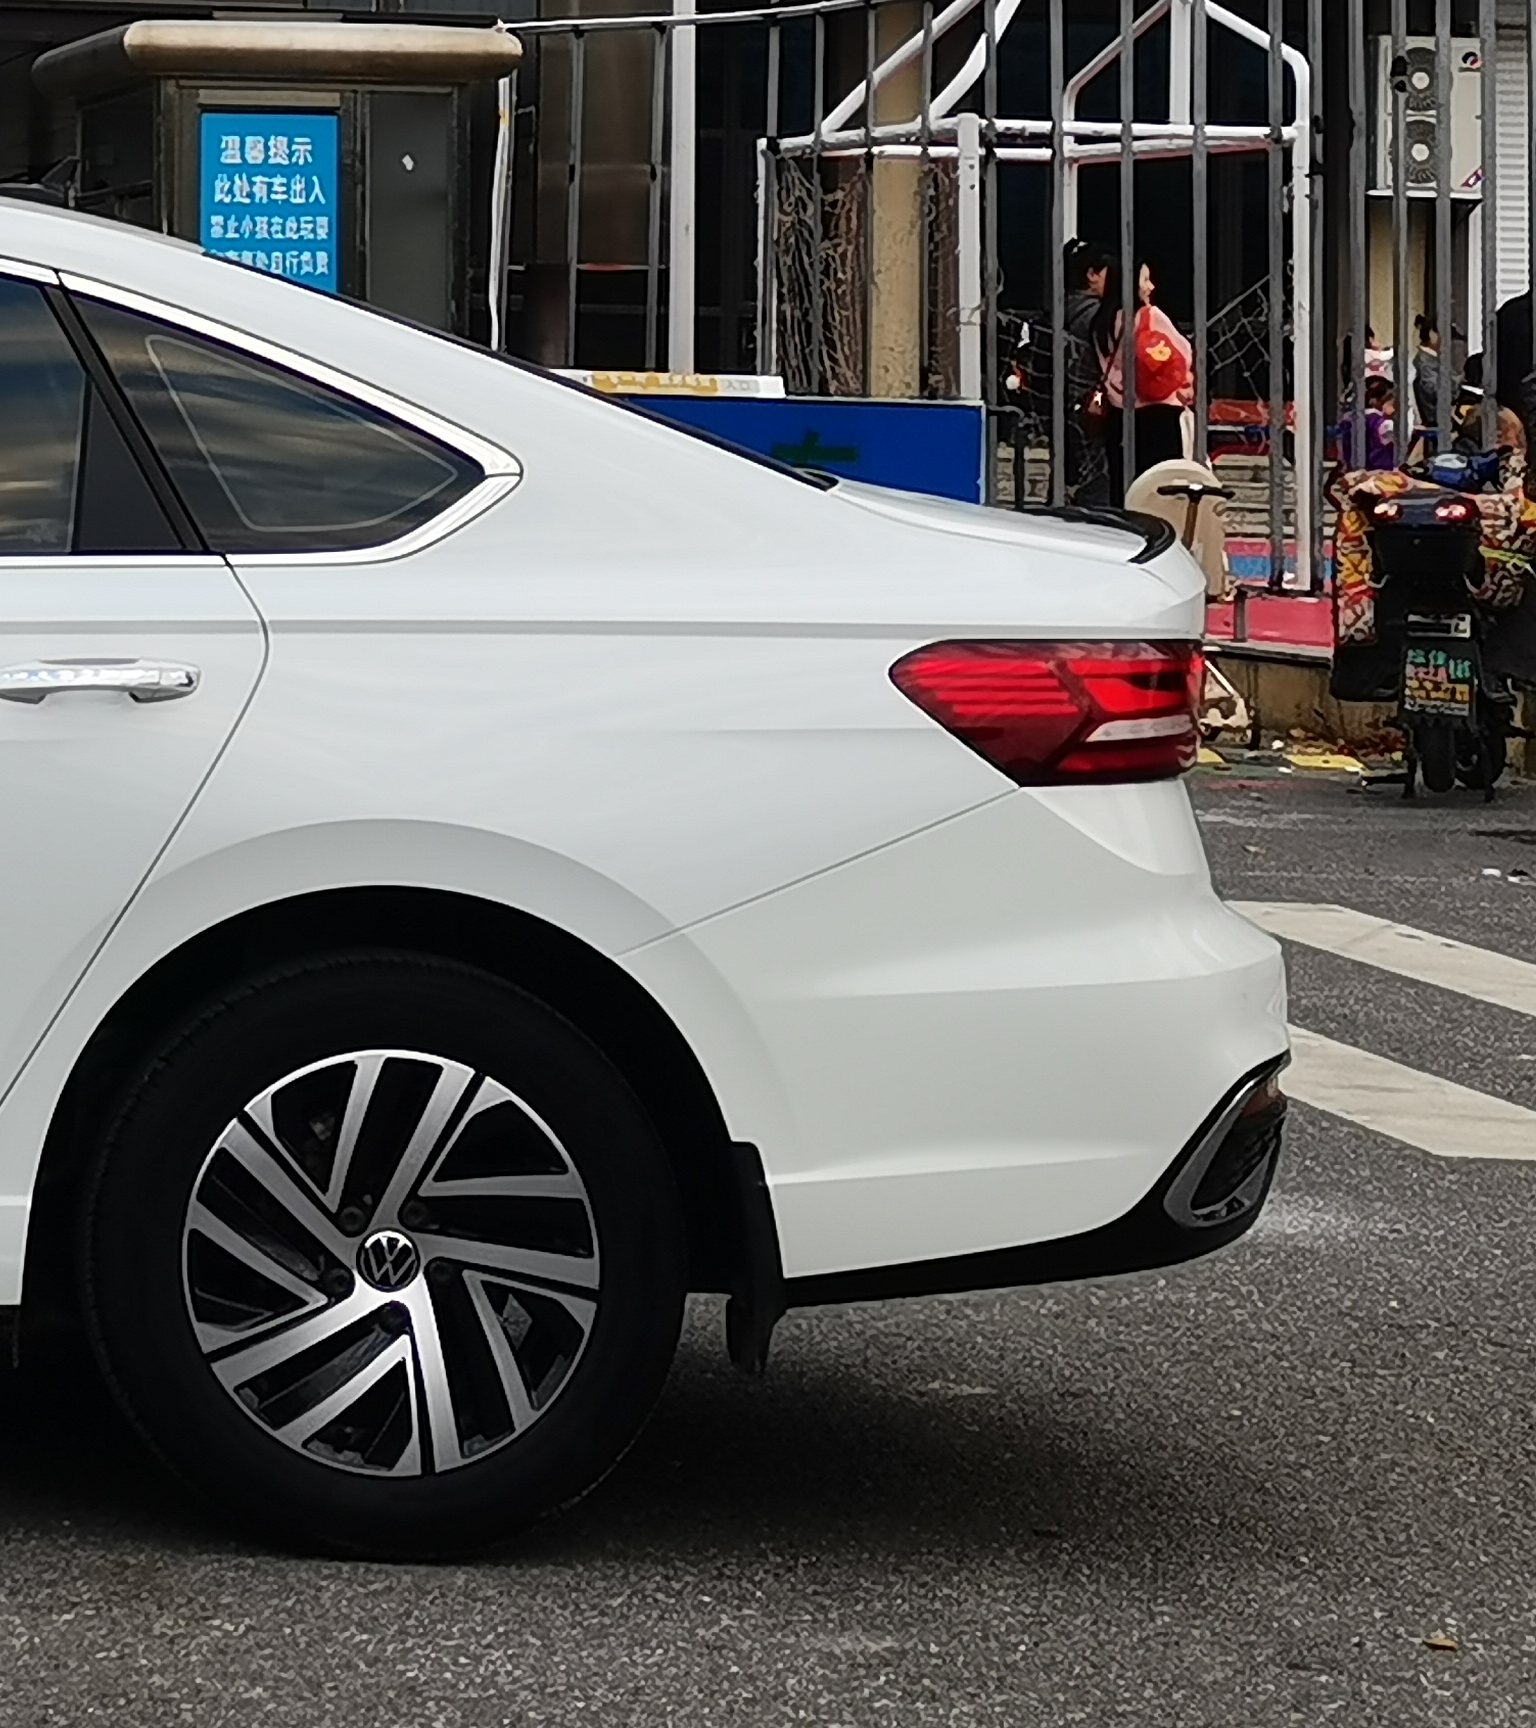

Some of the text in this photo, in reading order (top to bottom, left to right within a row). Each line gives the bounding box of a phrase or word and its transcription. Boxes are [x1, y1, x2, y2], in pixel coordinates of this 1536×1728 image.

[219, 135, 313, 165] 温馨提示
[214, 173, 326, 205] 此处有车出入
